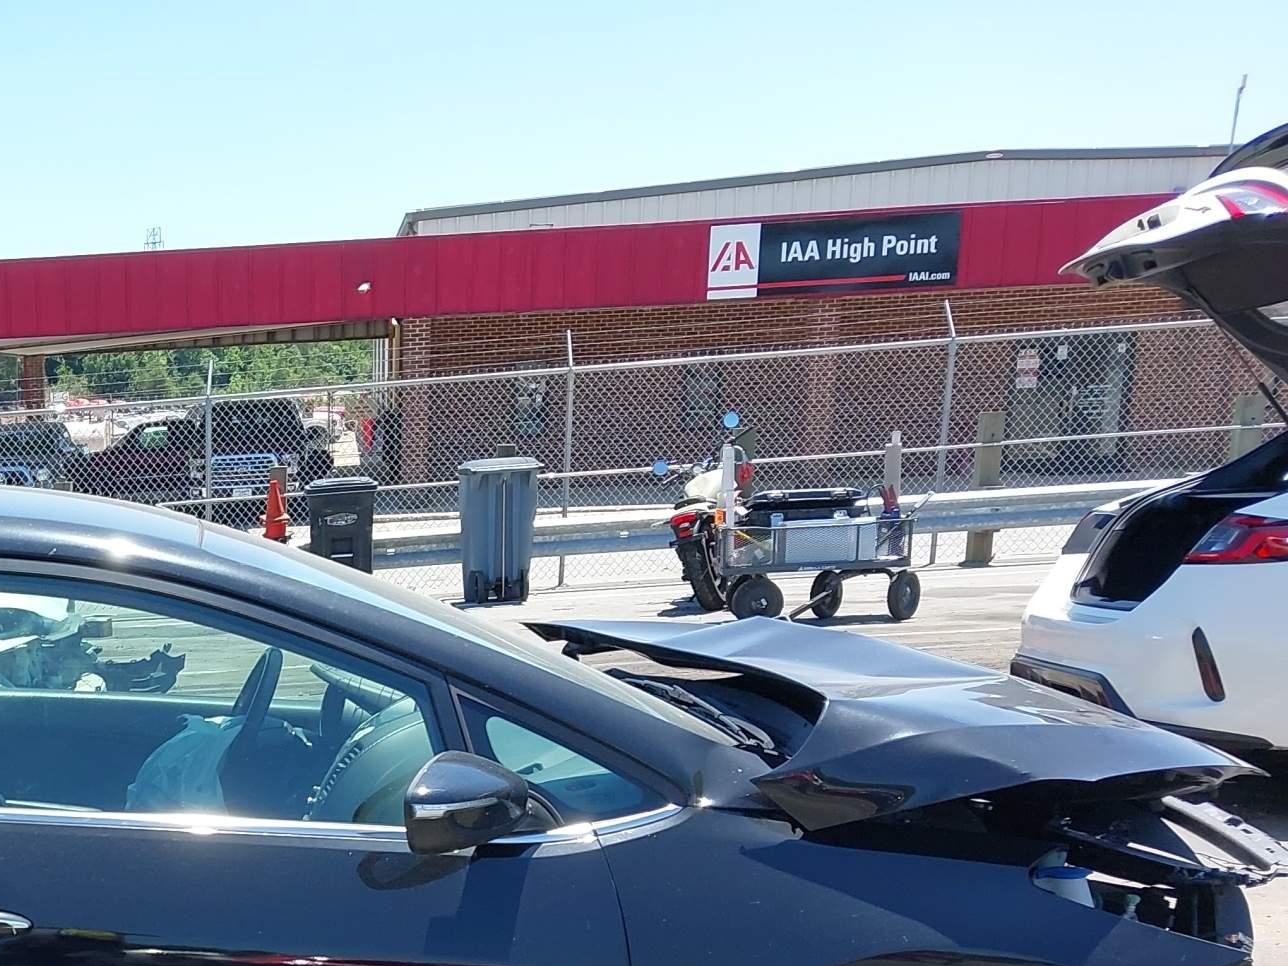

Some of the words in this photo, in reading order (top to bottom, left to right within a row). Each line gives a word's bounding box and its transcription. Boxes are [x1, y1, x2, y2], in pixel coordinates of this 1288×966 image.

[780, 240, 820, 263] IAA
[826, 237, 875, 263] High
[882, 234, 938, 257] Point
[908, 271, 951, 281] IAAI.com
